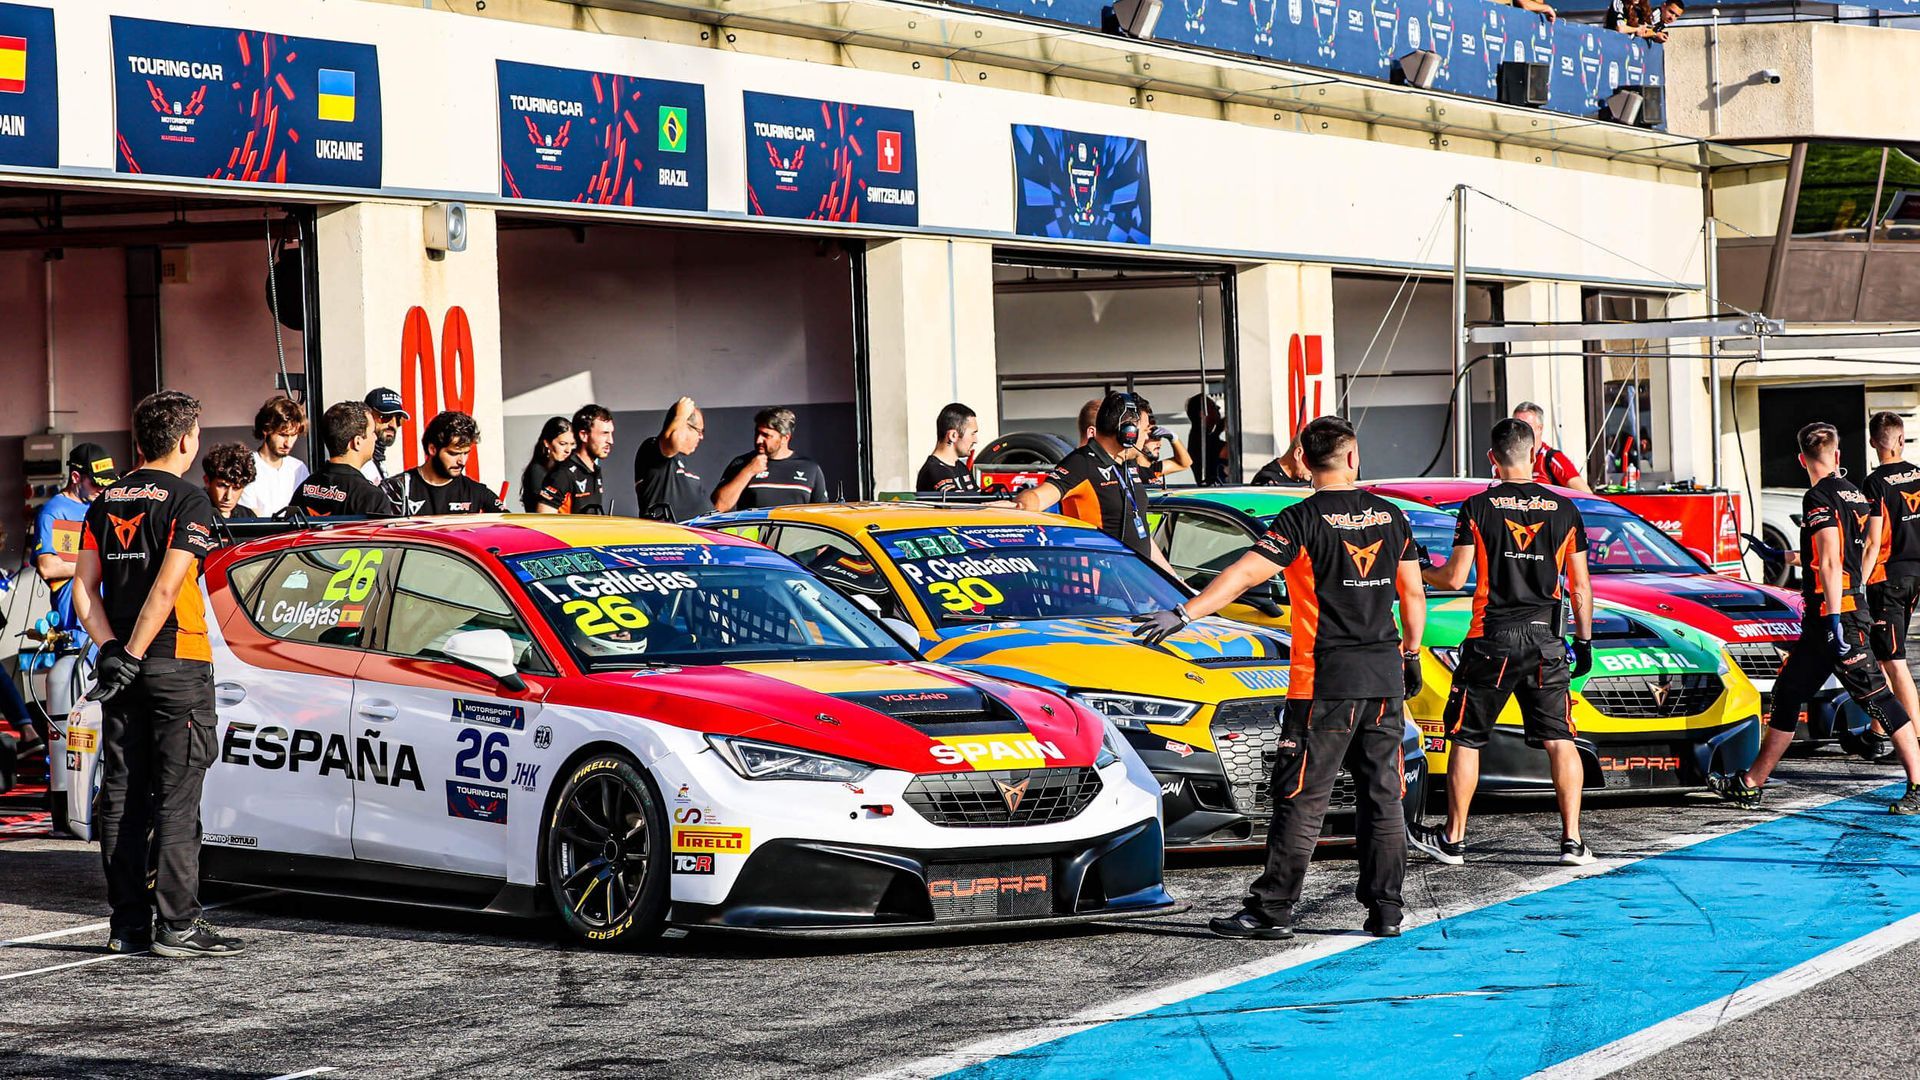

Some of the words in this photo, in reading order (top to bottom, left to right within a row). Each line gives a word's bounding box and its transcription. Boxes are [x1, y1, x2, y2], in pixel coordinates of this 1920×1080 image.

[128, 56, 190, 78] TOURING
[191, 62, 223, 81] CAR
[510, 94, 558, 115] TOURING
[558, 101, 583, 117] CAR
[754, 122, 794, 140] TOURING
[795, 127, 815, 142] CAR
[316, 139, 363, 161] UKRAINE
[659, 168, 689, 187] BRAZIL
[867, 186, 915, 205] SWITZERLAND
[1489, 495, 1558, 512] VOLCANO
[1322, 507, 1392, 529] VOLCANO
[323, 547, 384, 603] 26
[900, 563, 935, 585] P.
[928, 556, 1039, 581] Chabanov
[566, 569, 698, 599] Callejas
[1343, 577, 1391, 588] CUPRA
[928, 578, 1004, 612] 30
[272, 600, 340, 630] Callejas
[562, 595, 650, 637] 26
[1732, 622, 1803, 638] SWITZERLA
[1599, 653, 1699, 671] BRAZIL
[465, 704, 512, 717] MOTORSPORT
[475, 714, 501, 724] GAMES
[68, 731, 95, 749] PIRELLI
[221, 720, 425, 791] ESPAÑA
[455, 728, 510, 783] 26
[929, 738, 1066, 765] SPAIN
[573, 759, 618, 784] PIRELLI
[1599, 756, 1680, 771] CUPRA
[511, 763, 541, 787] JHK
[457, 785, 490, 798] TOURING
[491, 792, 507, 801] CAR
[677, 830, 743, 849] PIRELLI
[674, 855, 712, 872] TCR
[928, 873, 1047, 898] CUPRA
